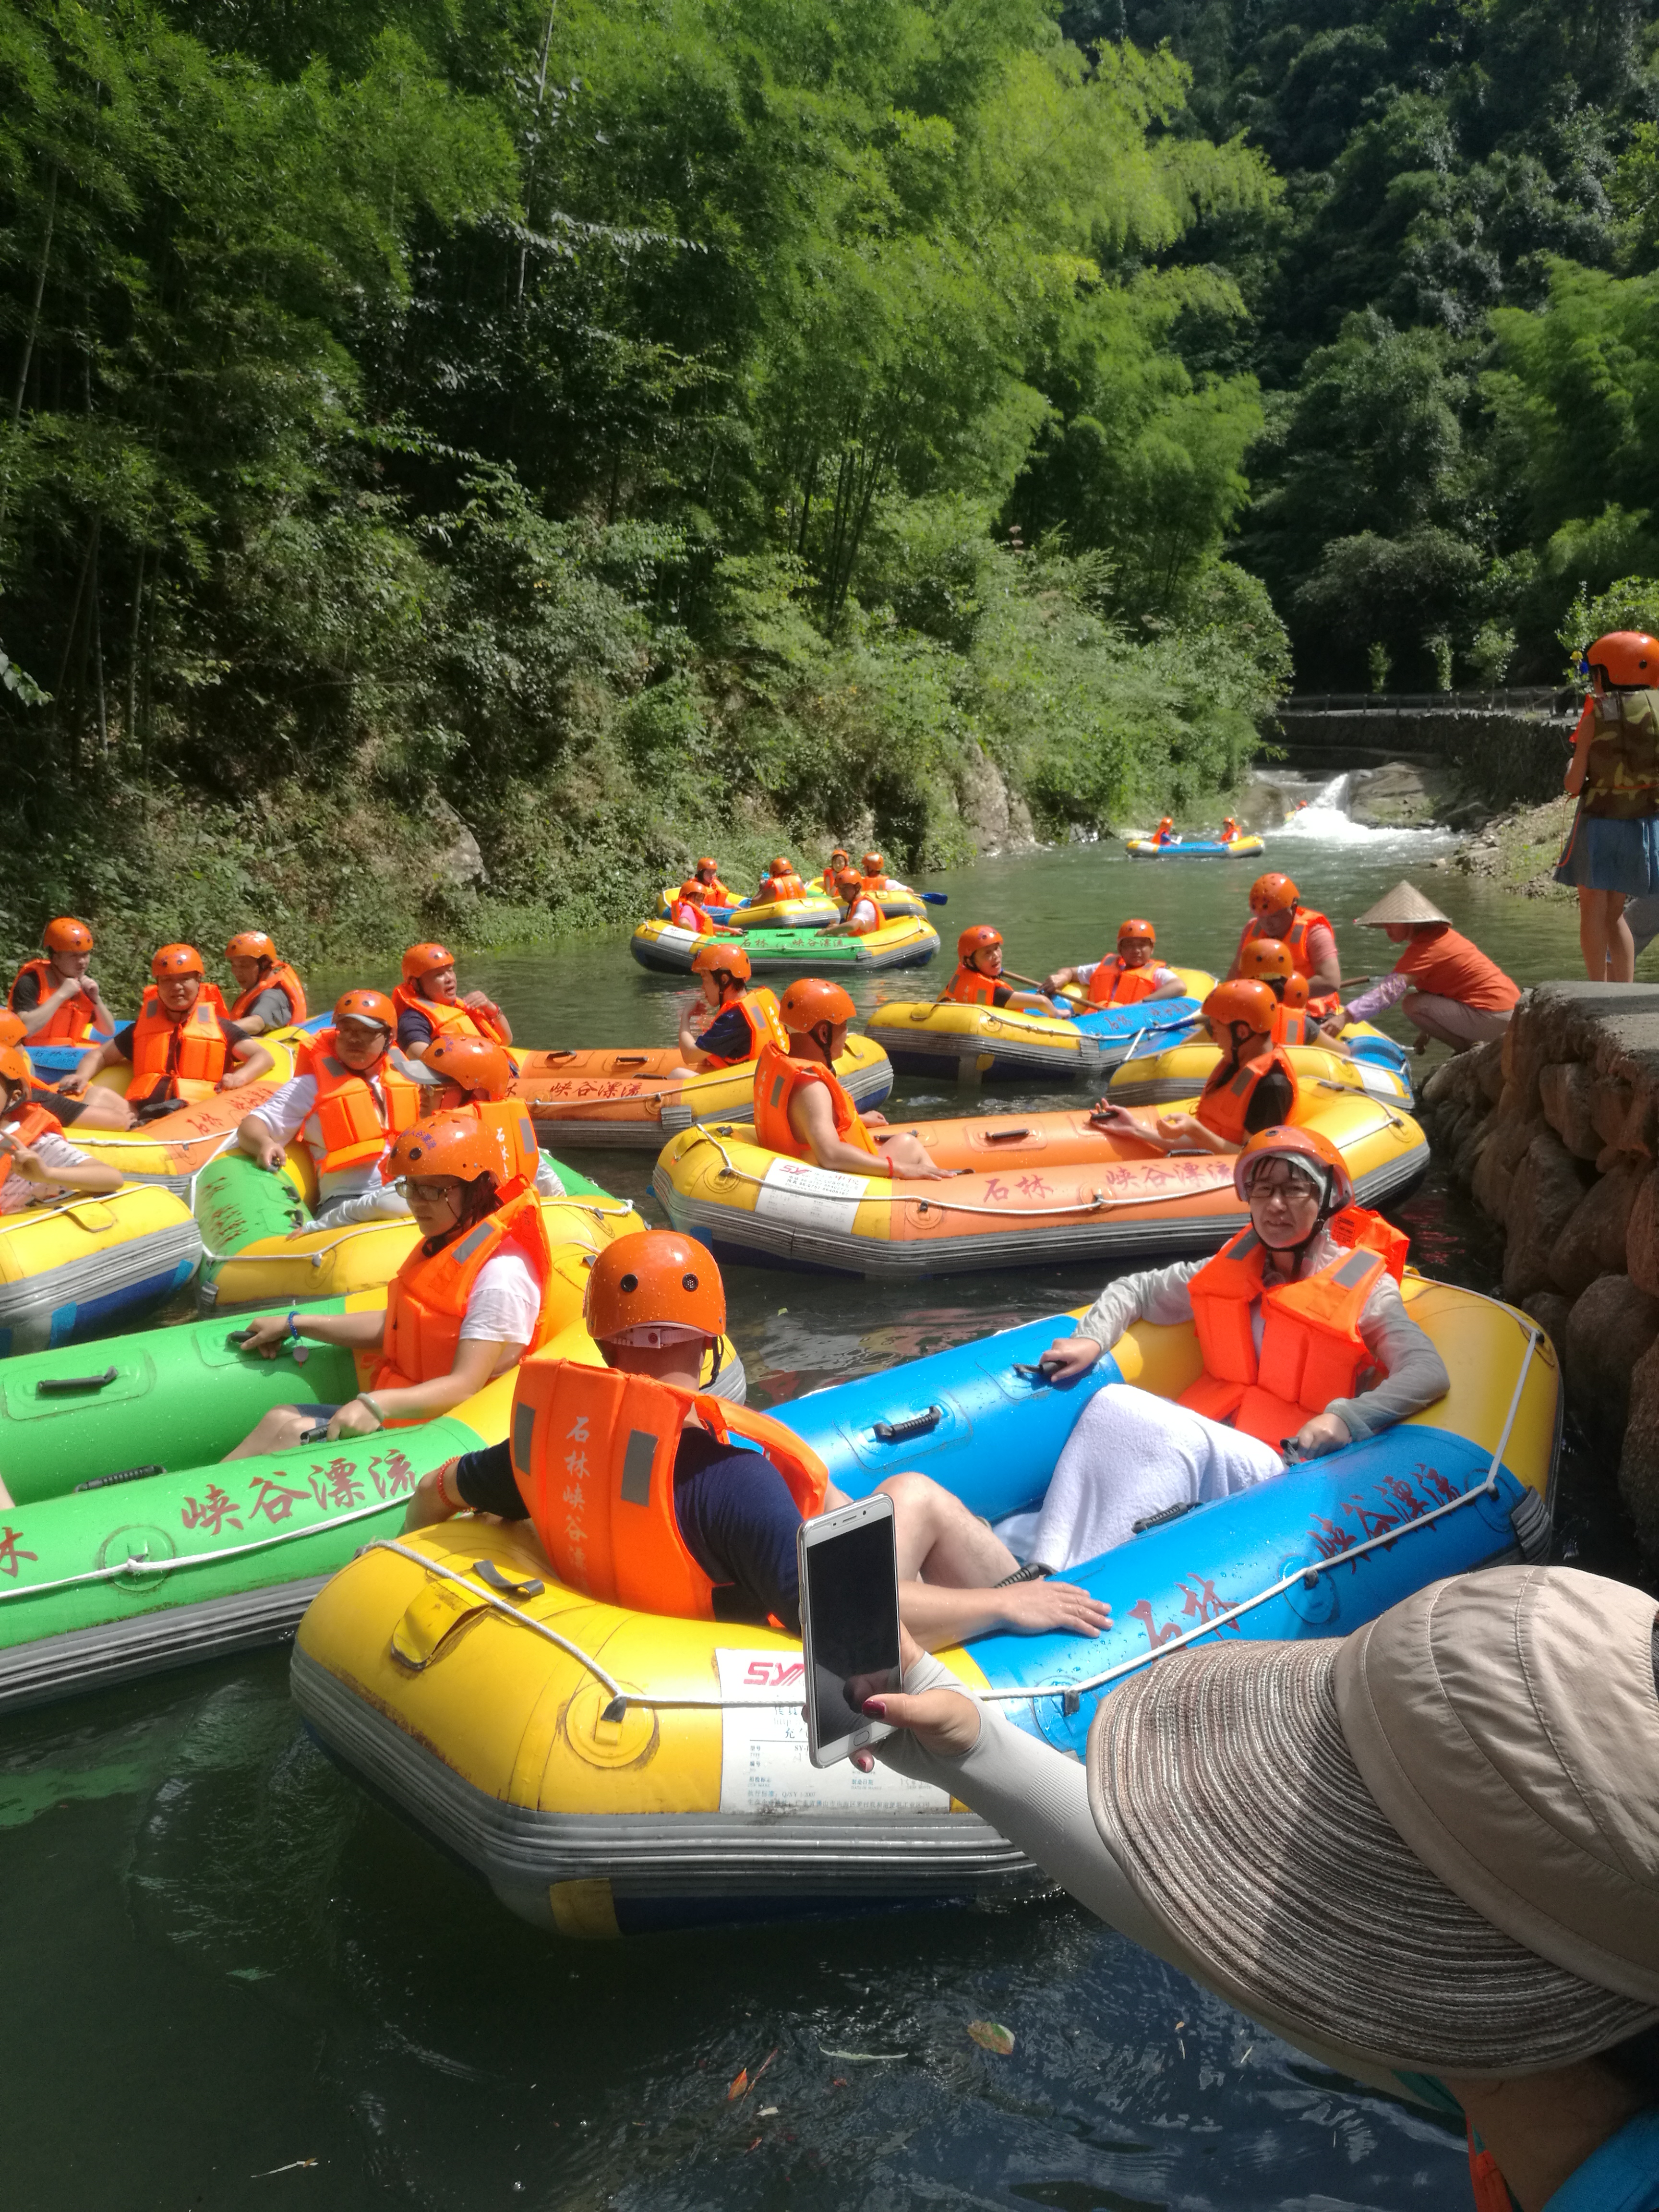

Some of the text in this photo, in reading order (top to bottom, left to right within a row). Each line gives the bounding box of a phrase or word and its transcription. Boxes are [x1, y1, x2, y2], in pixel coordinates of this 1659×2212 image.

[741, 938, 843, 948] 石林 峡谷漂流
[550, 1081, 643, 1098] 峡谷漂流
[983, 1160, 1234, 1202] 石林 峡谷漂流
[181, 1448, 418, 1536] 峡谷漂流
